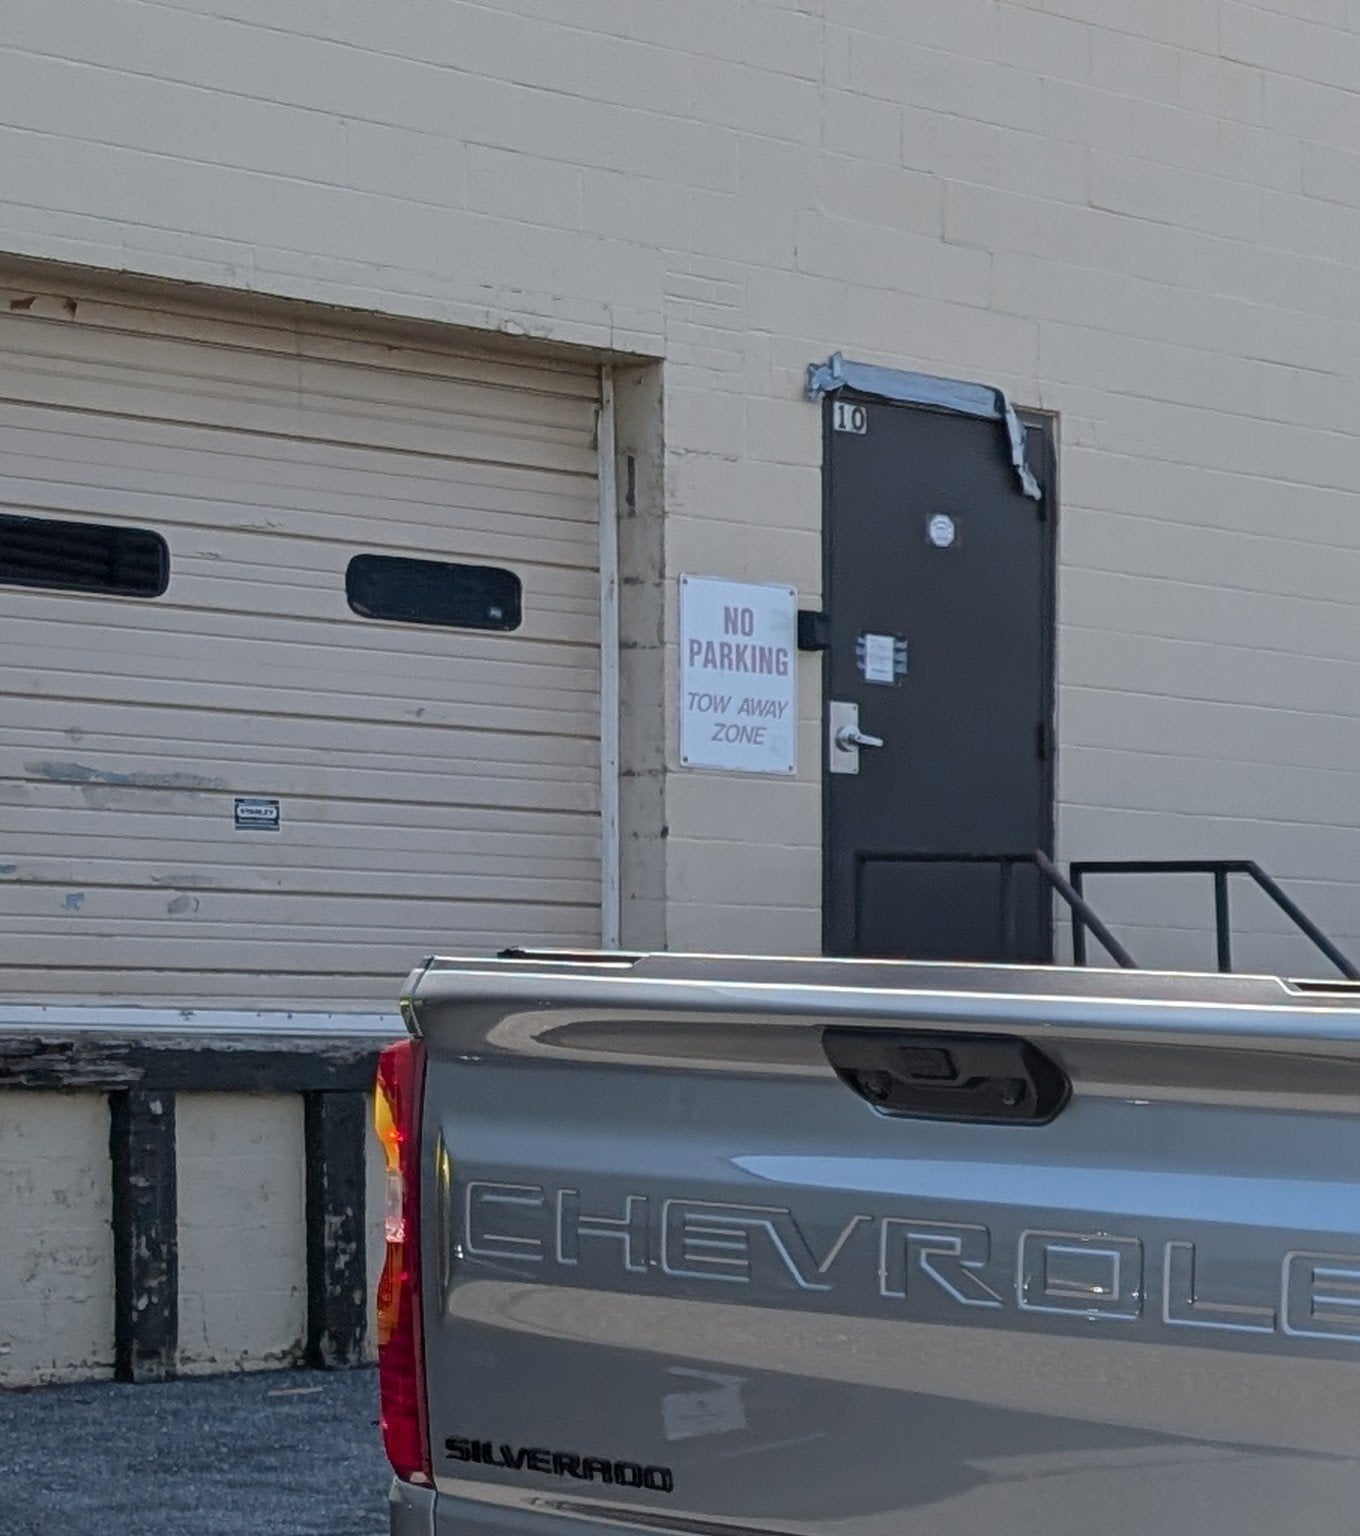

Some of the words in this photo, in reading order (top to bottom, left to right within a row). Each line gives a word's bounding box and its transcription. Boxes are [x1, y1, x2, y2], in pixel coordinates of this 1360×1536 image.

[838, 405, 864, 431] 10
[724, 606, 754, 637] NO
[690, 639, 788, 676] PARKING
[688, 692, 731, 713] TOW
[737, 697, 789, 719] AWAY
[711, 723, 767, 745] ZONE
[445, 1436, 673, 1493] SILVERADO
